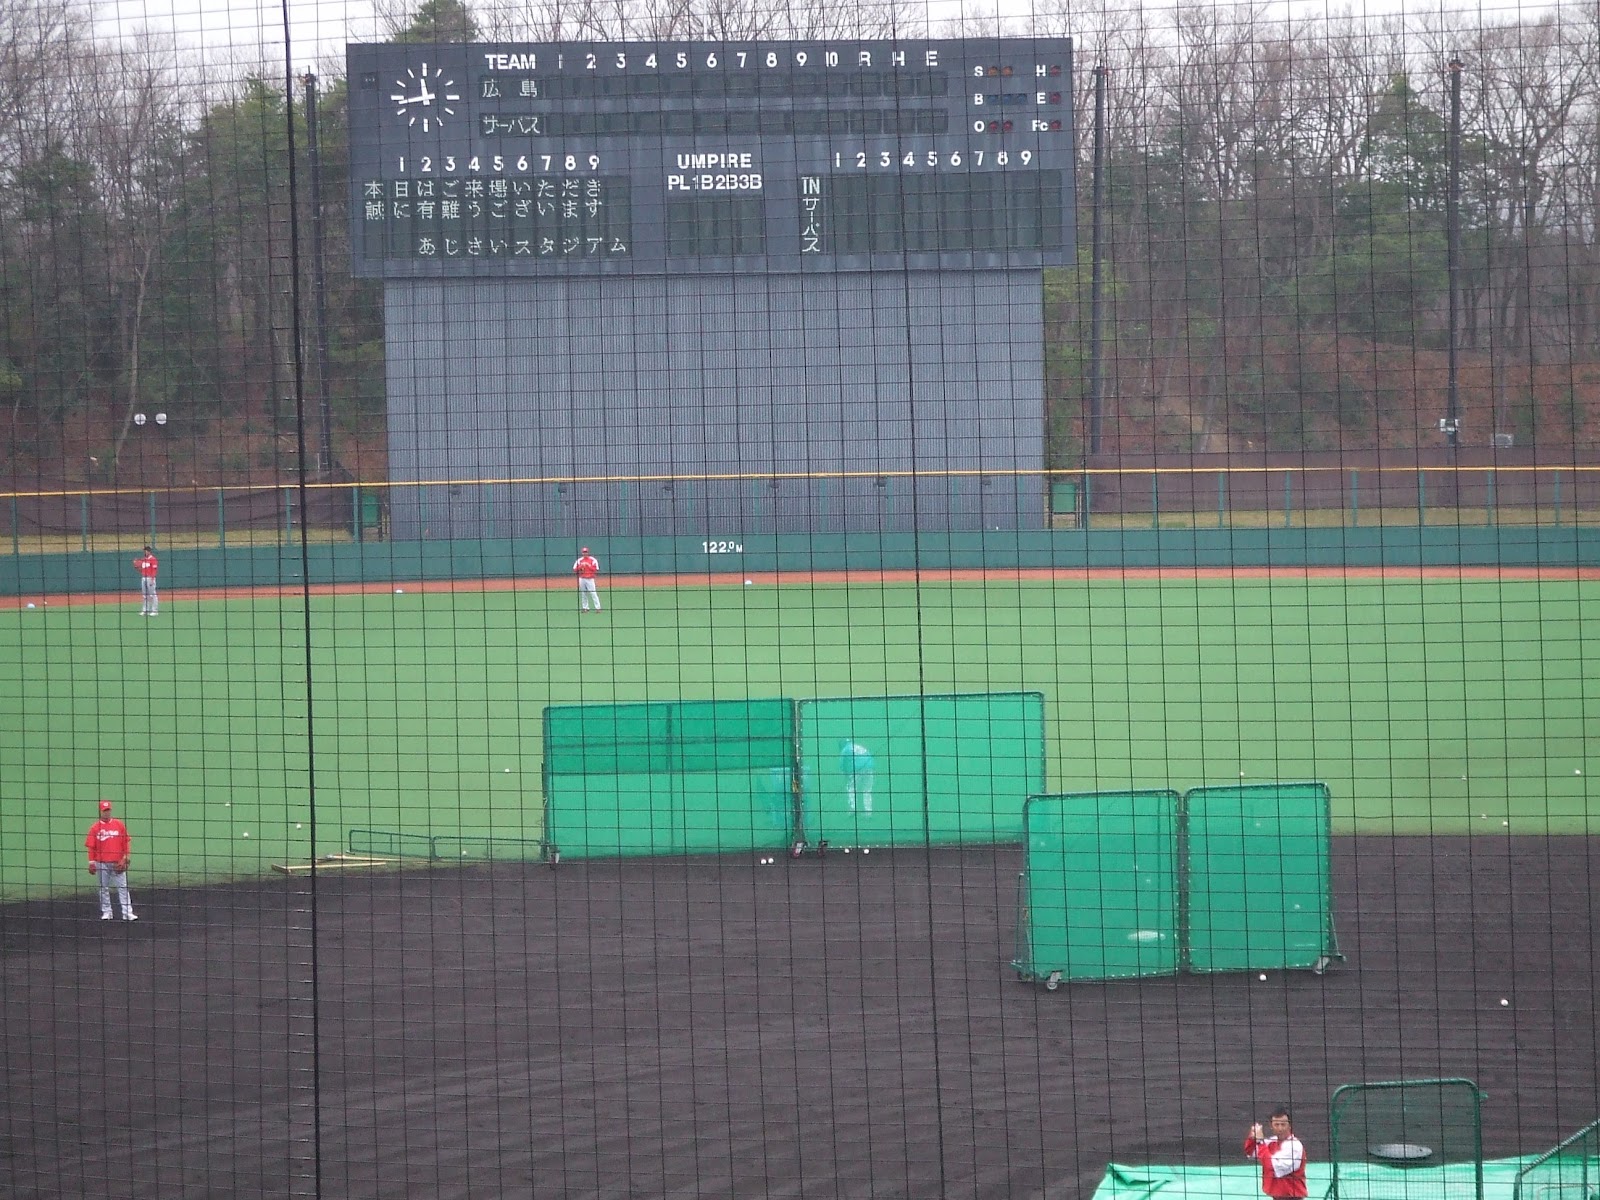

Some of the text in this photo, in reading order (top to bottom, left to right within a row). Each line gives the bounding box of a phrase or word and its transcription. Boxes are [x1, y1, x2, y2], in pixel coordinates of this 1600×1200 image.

[485, 50, 938, 70] TEAM 1 2 3 4 5 6 7 8 9 10 R H E
[974, 66, 984, 77] S
[1036, 64, 1046, 77] H
[974, 93, 984, 105] B
[1036, 92, 1046, 105] E
[400, 154, 600, 172] 1 2 3 4 5 6 7 8 9
[677, 153, 752, 169] UMPIRE
[836, 150, 1032, 168] 1 2 3 4 5 6 7 8 9
